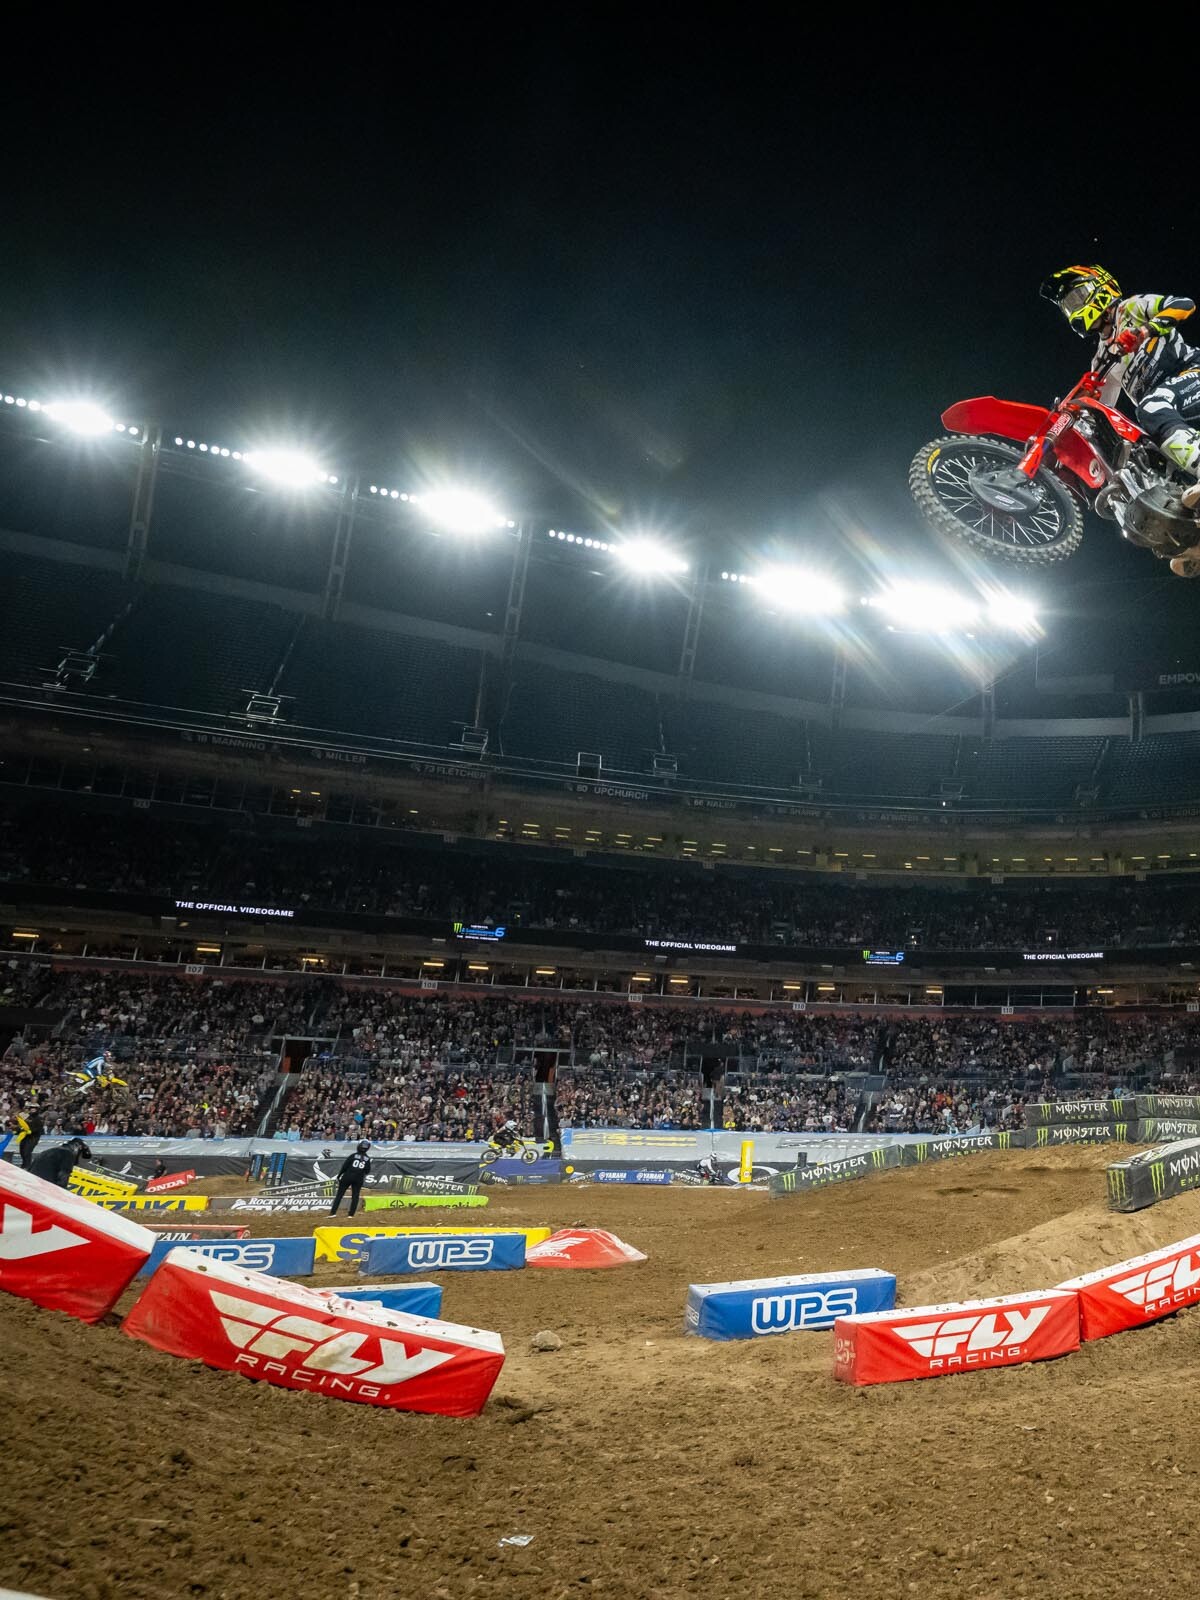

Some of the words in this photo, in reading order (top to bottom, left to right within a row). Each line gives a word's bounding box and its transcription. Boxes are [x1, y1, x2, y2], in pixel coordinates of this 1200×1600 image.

[325, 752, 366, 764] MILLER
[593, 787, 649, 800] UPCHURCH
[175, 901, 194, 909] THE
[196, 903, 238, 912] OFFICIAL
[240, 906, 295, 917] VIDEOGAME
[495, 927, 506, 937] 6
[660, 941, 693, 949] OFFICIAL
[694, 943, 736, 951] VIDEOGAME
[1055, 1101, 1109, 1114] MONSTER
[1157, 1097, 1195, 1109] MONSTER
[1053, 1126, 1111, 1139] MONSTER
[1156, 1120, 1198, 1135] MONSTER
[933, 1136, 993, 1152] MONSTER
[801, 1156, 867, 1180] MONSTER
[812, 1169, 858, 1185] ENERGY
[146, 1179, 186, 1192] ONDA
[416, 1181, 464, 1192] MONSTER
[248, 1197, 279, 1206] ROCKY
[281, 1197, 333, 1206] MOUNTAIN
[156, 1232, 191, 1241] TAIN
[408, 1240, 494, 1268] WPS
[751, 1288, 857, 1335] WPS
[209, 1290, 456, 1384] FLY
[892, 1305, 1051, 1357] FLY
[930, 1347, 1021, 1369] RACING
[235, 1353, 382, 1398] RACING
